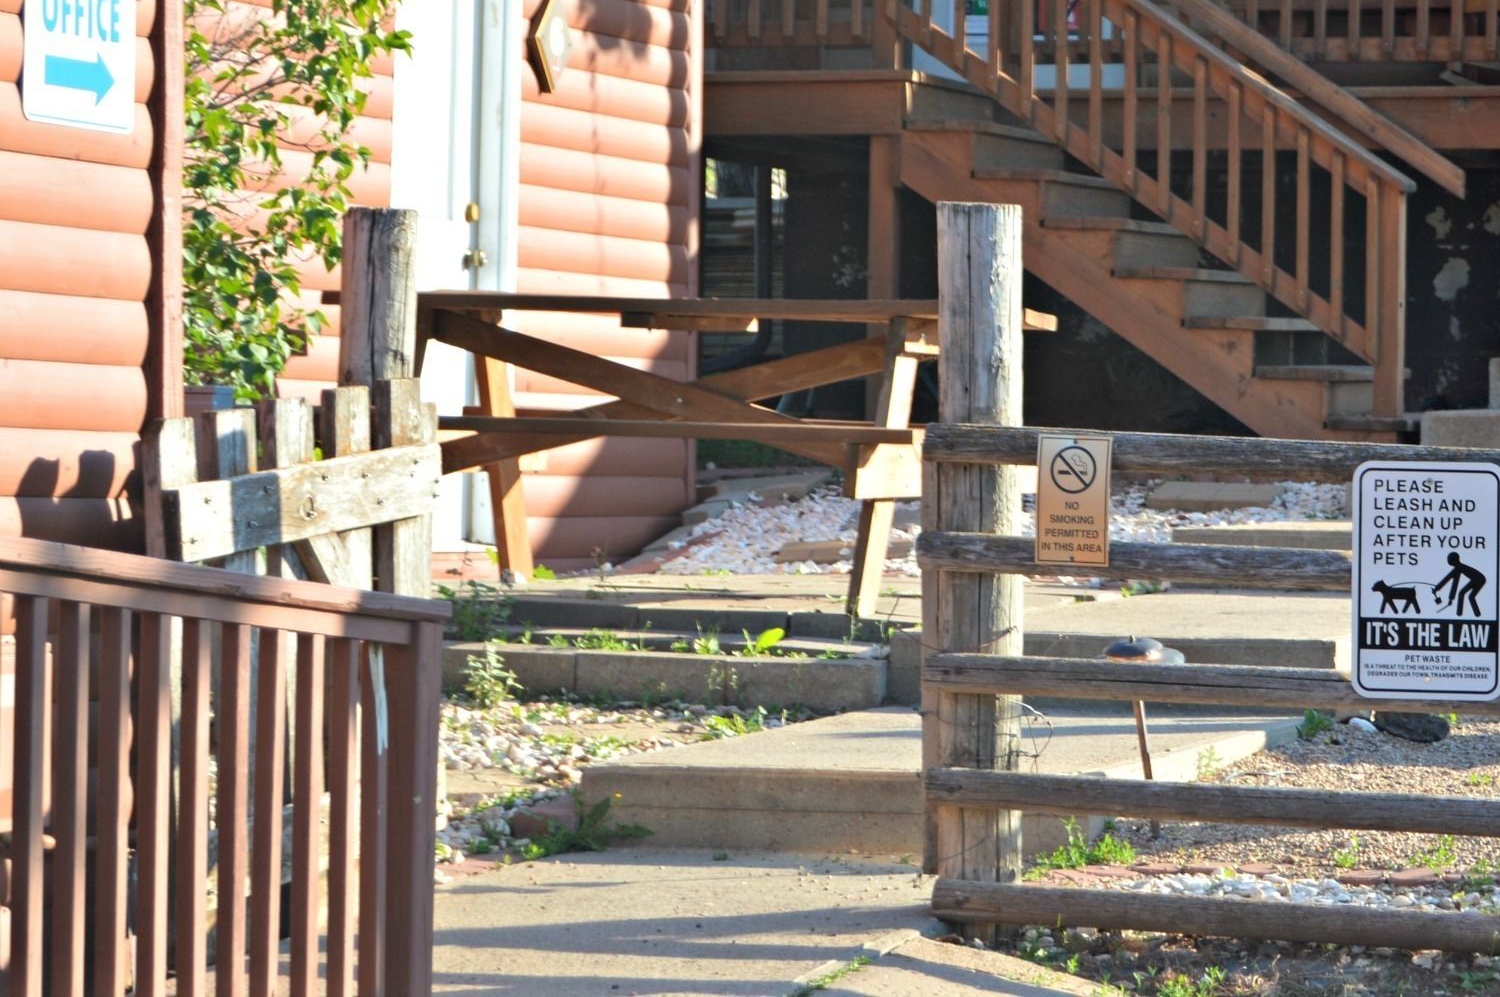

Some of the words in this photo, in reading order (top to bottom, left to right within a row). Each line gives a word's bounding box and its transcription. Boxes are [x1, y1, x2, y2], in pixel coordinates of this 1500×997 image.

[1374, 479, 1444, 493] PLEASE
[1064, 501, 1080, 511] NO
[1374, 497, 1433, 511] LEASH
[1438, 499, 1476, 512] AND
[1049, 514, 1095, 525] SMOKING
[1373, 515, 1434, 529] CLEAN
[1440, 517, 1463, 530] UP
[1044, 528, 1099, 539] PERMITTED
[1041, 541, 1051, 551] IN
[1053, 542, 1074, 552] THIS
[1076, 543, 1102, 553] AREA
[1373, 534, 1432, 548] AFTER
[1437, 535, 1486, 549] YOUR
[1373, 552, 1418, 566] PETS
[1366, 621, 1399, 647] IT'S
[1405, 622, 1441, 647] THE
[1447, 624, 1490, 649] LAW
[1404, 654, 1420, 663] PET
[1422, 655, 1451, 664] WASTE
